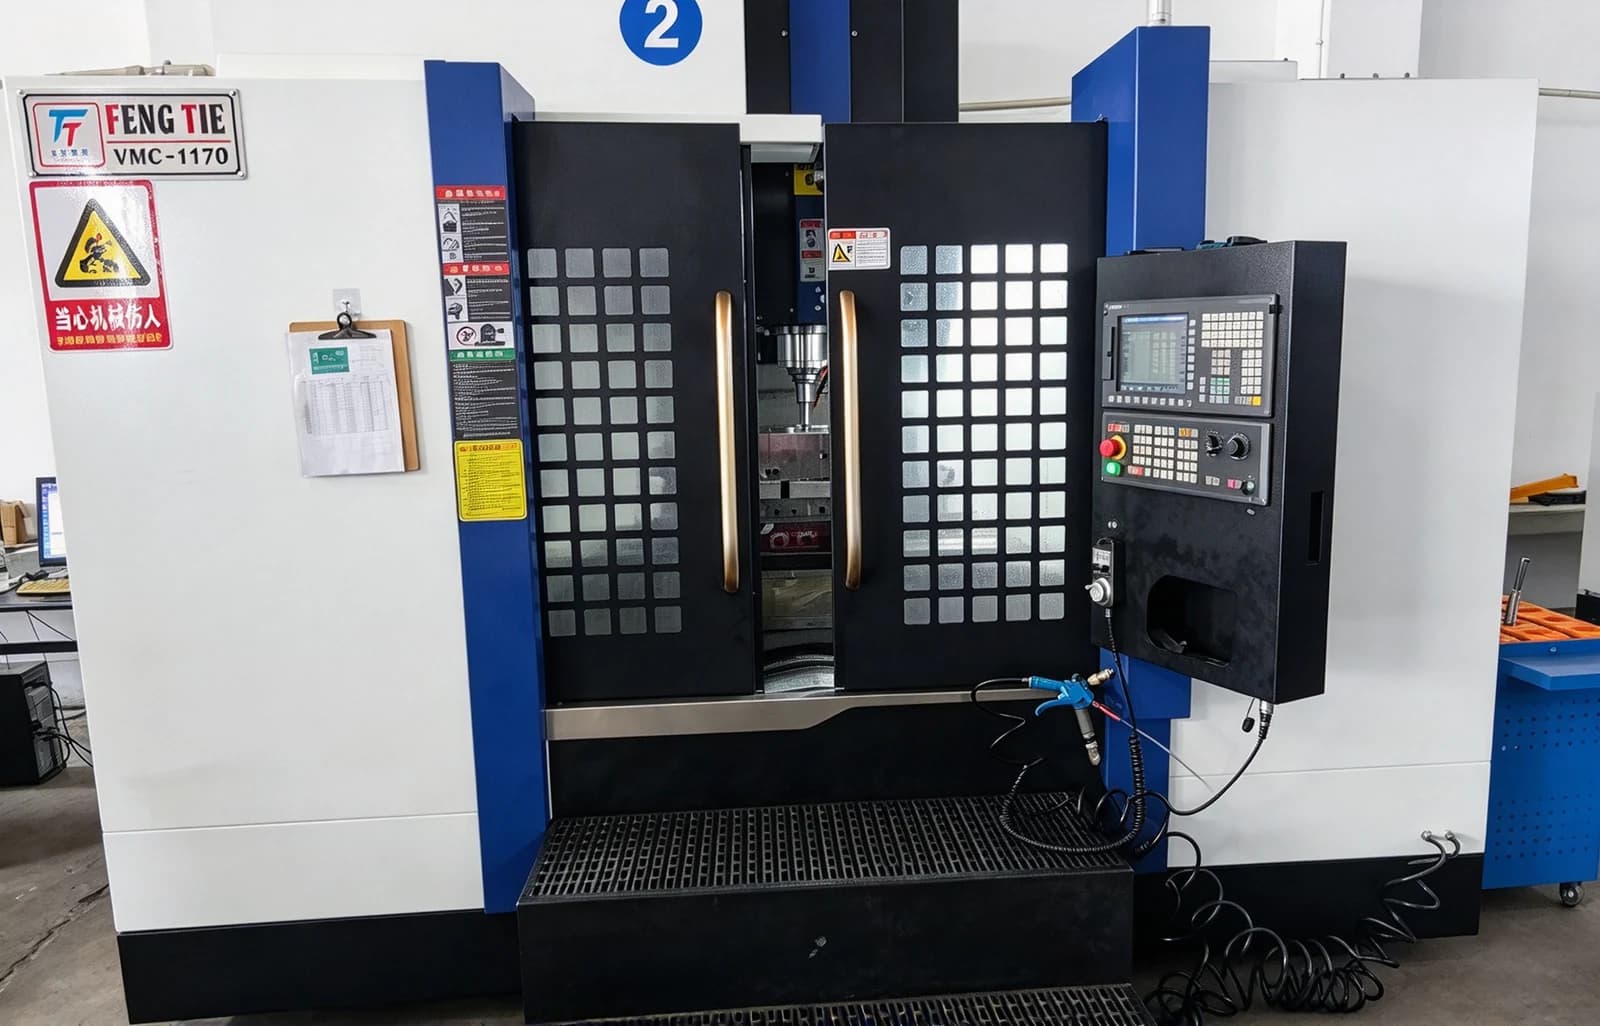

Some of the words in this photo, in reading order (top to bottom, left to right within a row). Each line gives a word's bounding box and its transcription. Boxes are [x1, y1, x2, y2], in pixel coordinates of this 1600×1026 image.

[644, 0, 680, 49] 2
[105, 104, 175, 135] FENG
[181, 103, 226, 134] TIE
[113, 147, 229, 165] VMC-1170
[55, 303, 161, 332] 当心机械伤人
